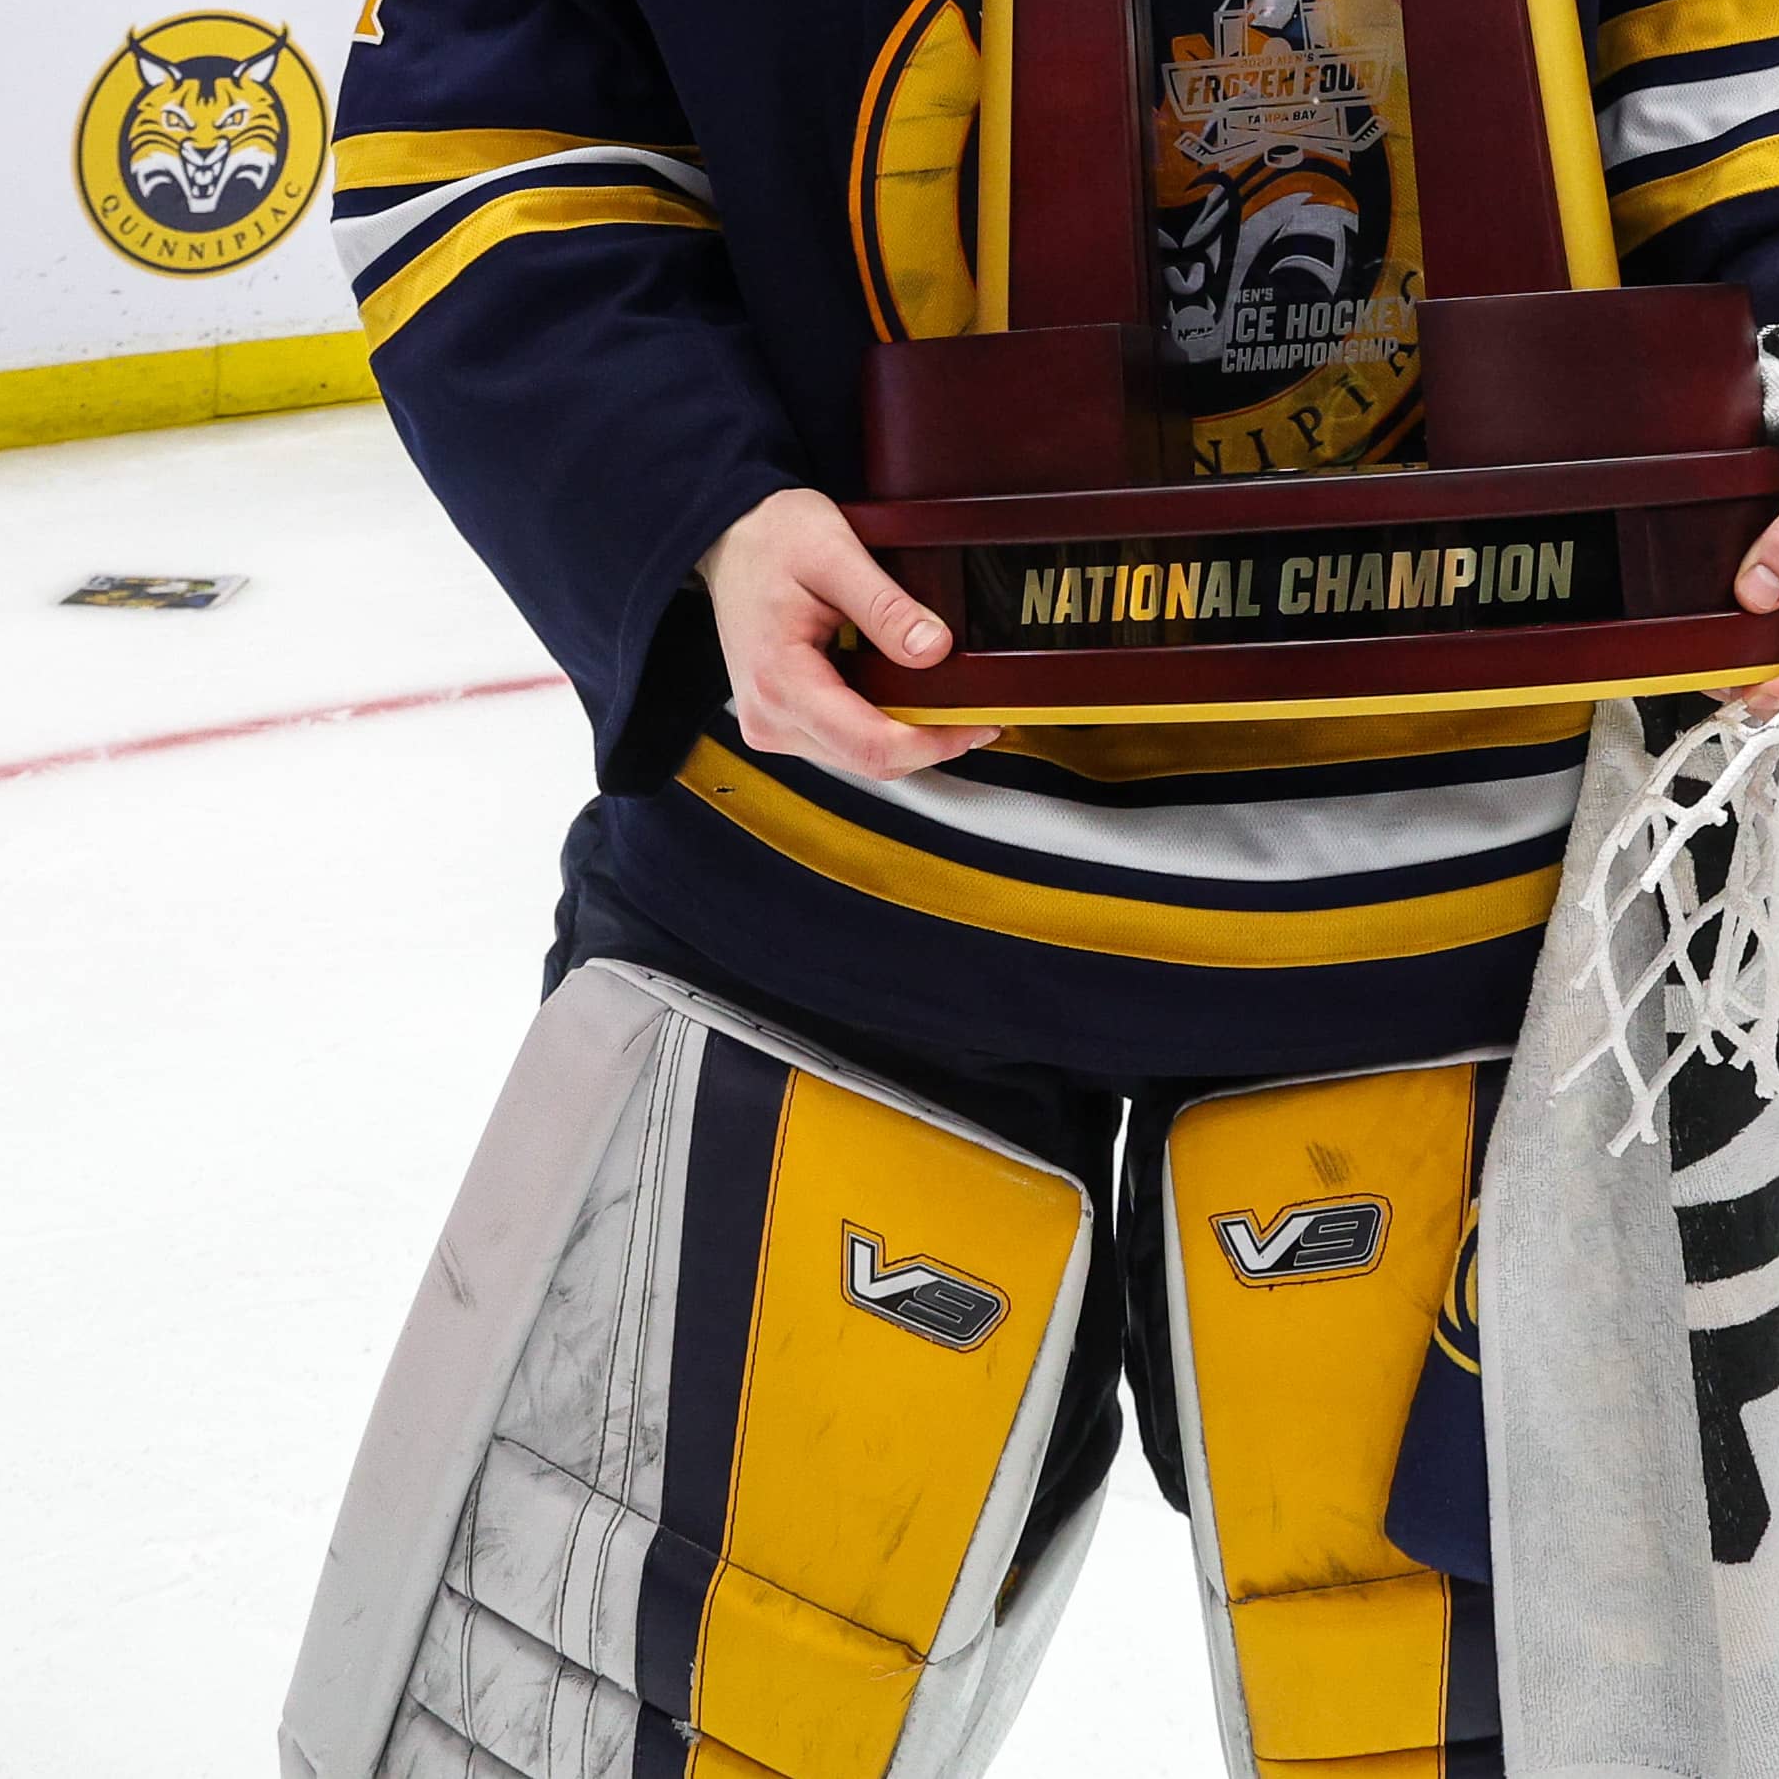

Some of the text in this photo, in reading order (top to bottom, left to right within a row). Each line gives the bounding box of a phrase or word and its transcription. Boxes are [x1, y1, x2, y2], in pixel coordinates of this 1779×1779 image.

[1186, 59, 1376, 107] FROZEN FOUR
[1293, 108, 1318, 122] BAY
[99, 180, 304, 262] QUINNIPIAC
[1285, 295, 1418, 341] HOCKEY
[1222, 336, 1399, 373] CHAMPIONSHIP
[1020, 539, 1575, 626] NATIONAL CHAMPION
[1224, 1204, 1383, 1273] V9
[846, 1229, 1001, 1341] V9
